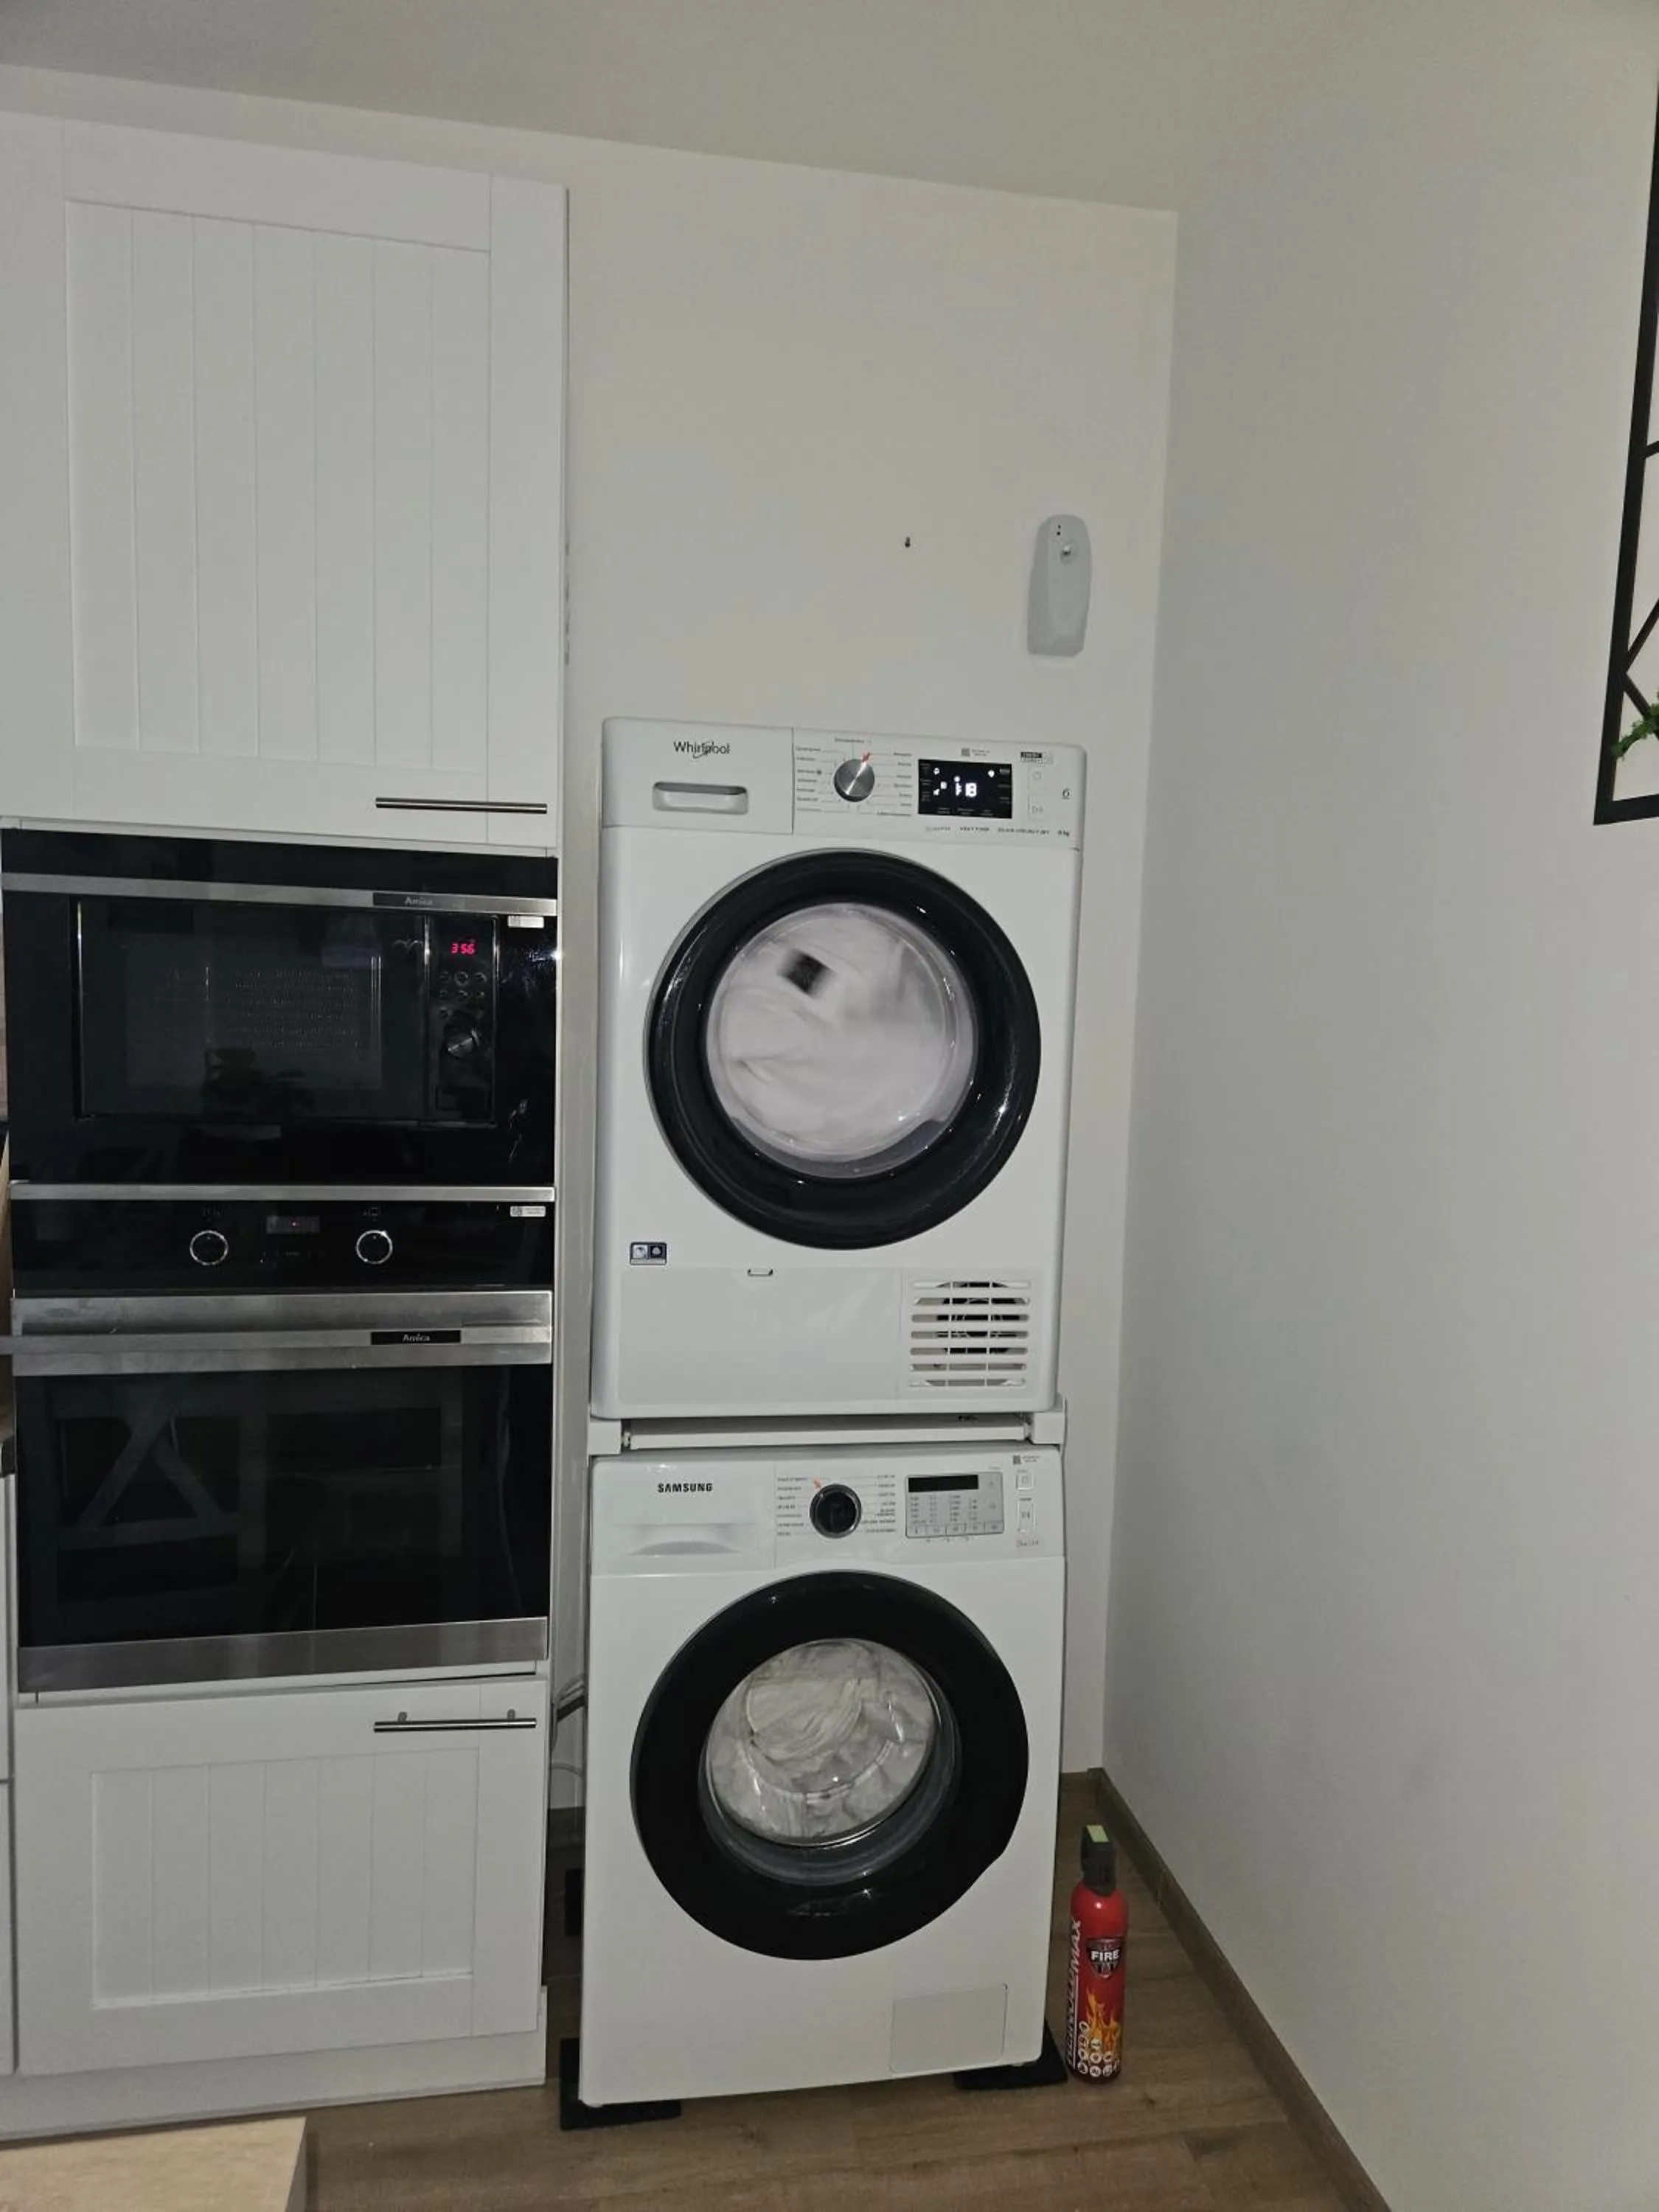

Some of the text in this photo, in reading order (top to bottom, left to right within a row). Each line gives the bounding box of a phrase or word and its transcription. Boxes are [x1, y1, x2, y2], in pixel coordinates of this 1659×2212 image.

[673, 740, 731, 759] Whirlpool
[658, 1482, 714, 1493] SAMSUNG
[1091, 1949, 1120, 1961] FIRE
